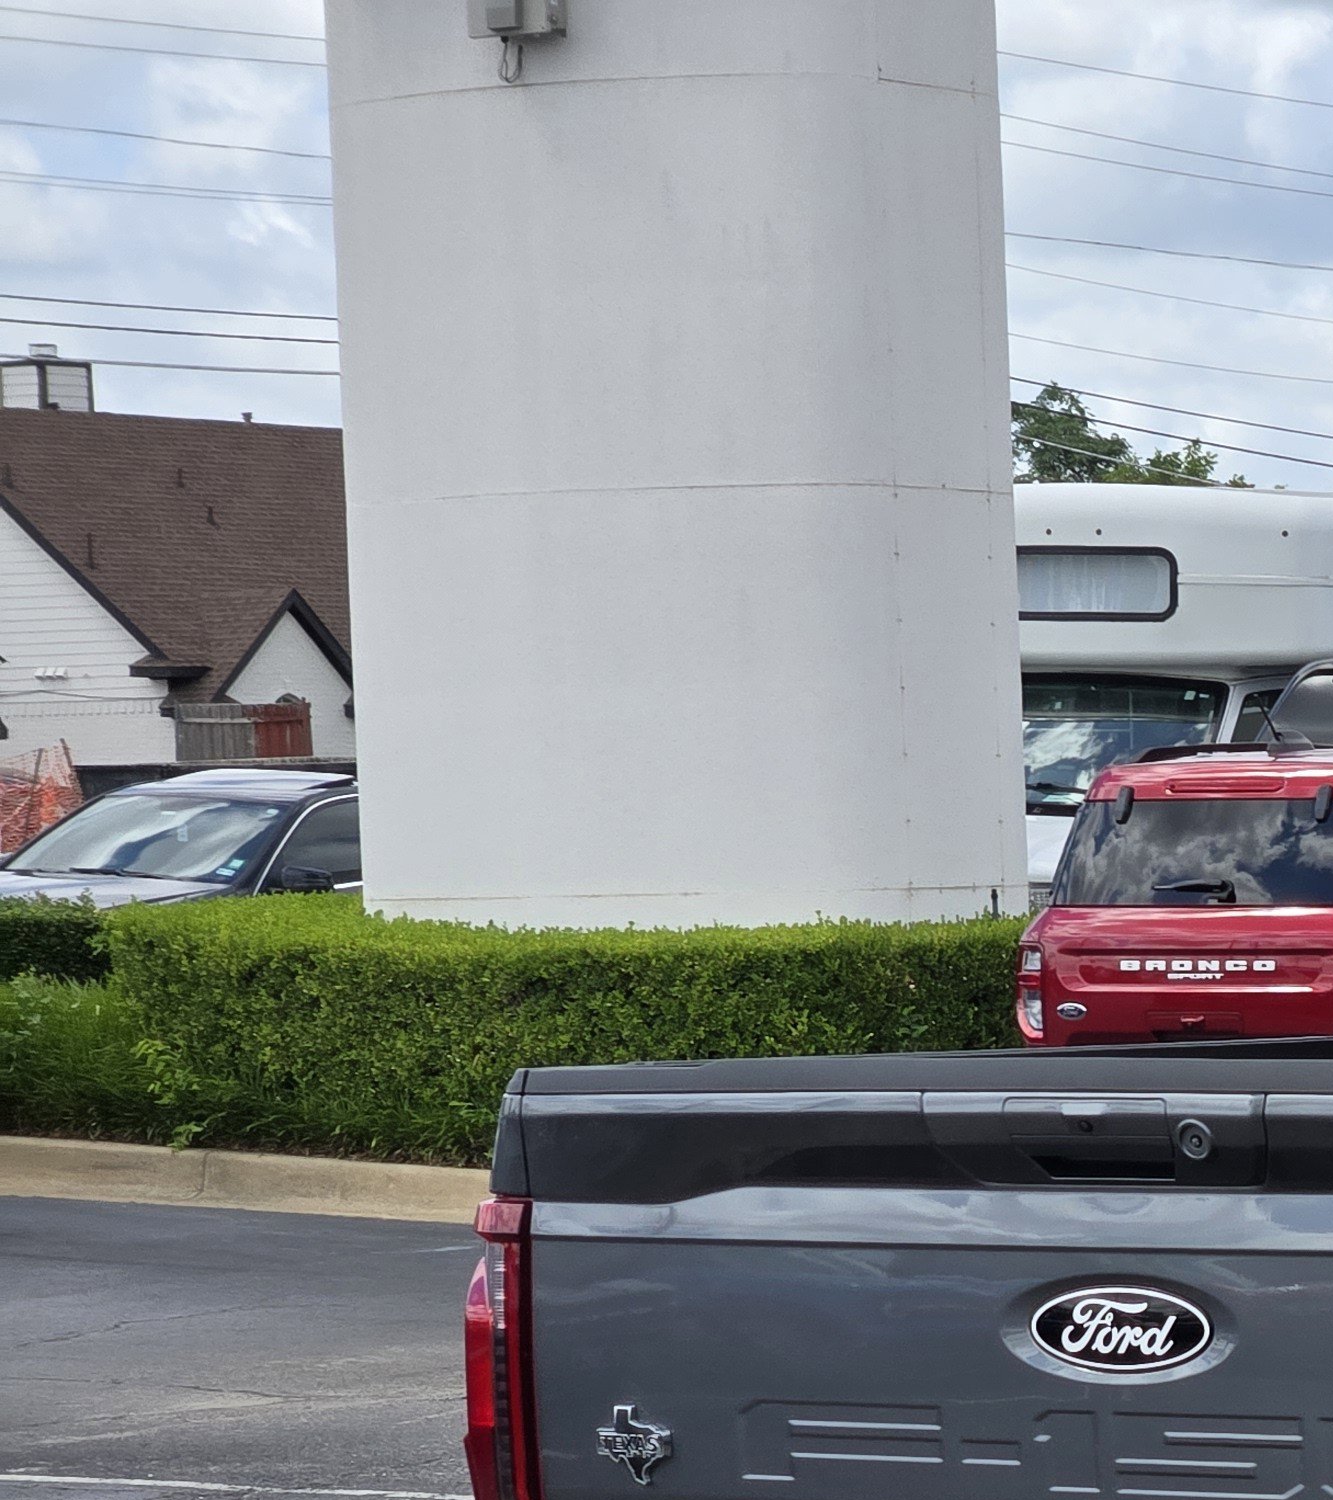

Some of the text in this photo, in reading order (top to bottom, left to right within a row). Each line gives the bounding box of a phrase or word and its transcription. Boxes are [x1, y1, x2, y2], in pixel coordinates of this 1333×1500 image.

[1119, 959, 1276, 972] BRONCO
[1166, 972, 1225, 980] SPORT
[1060, 1296, 1178, 1358] Ford
[598, 1433, 661, 1456] TEXAS
